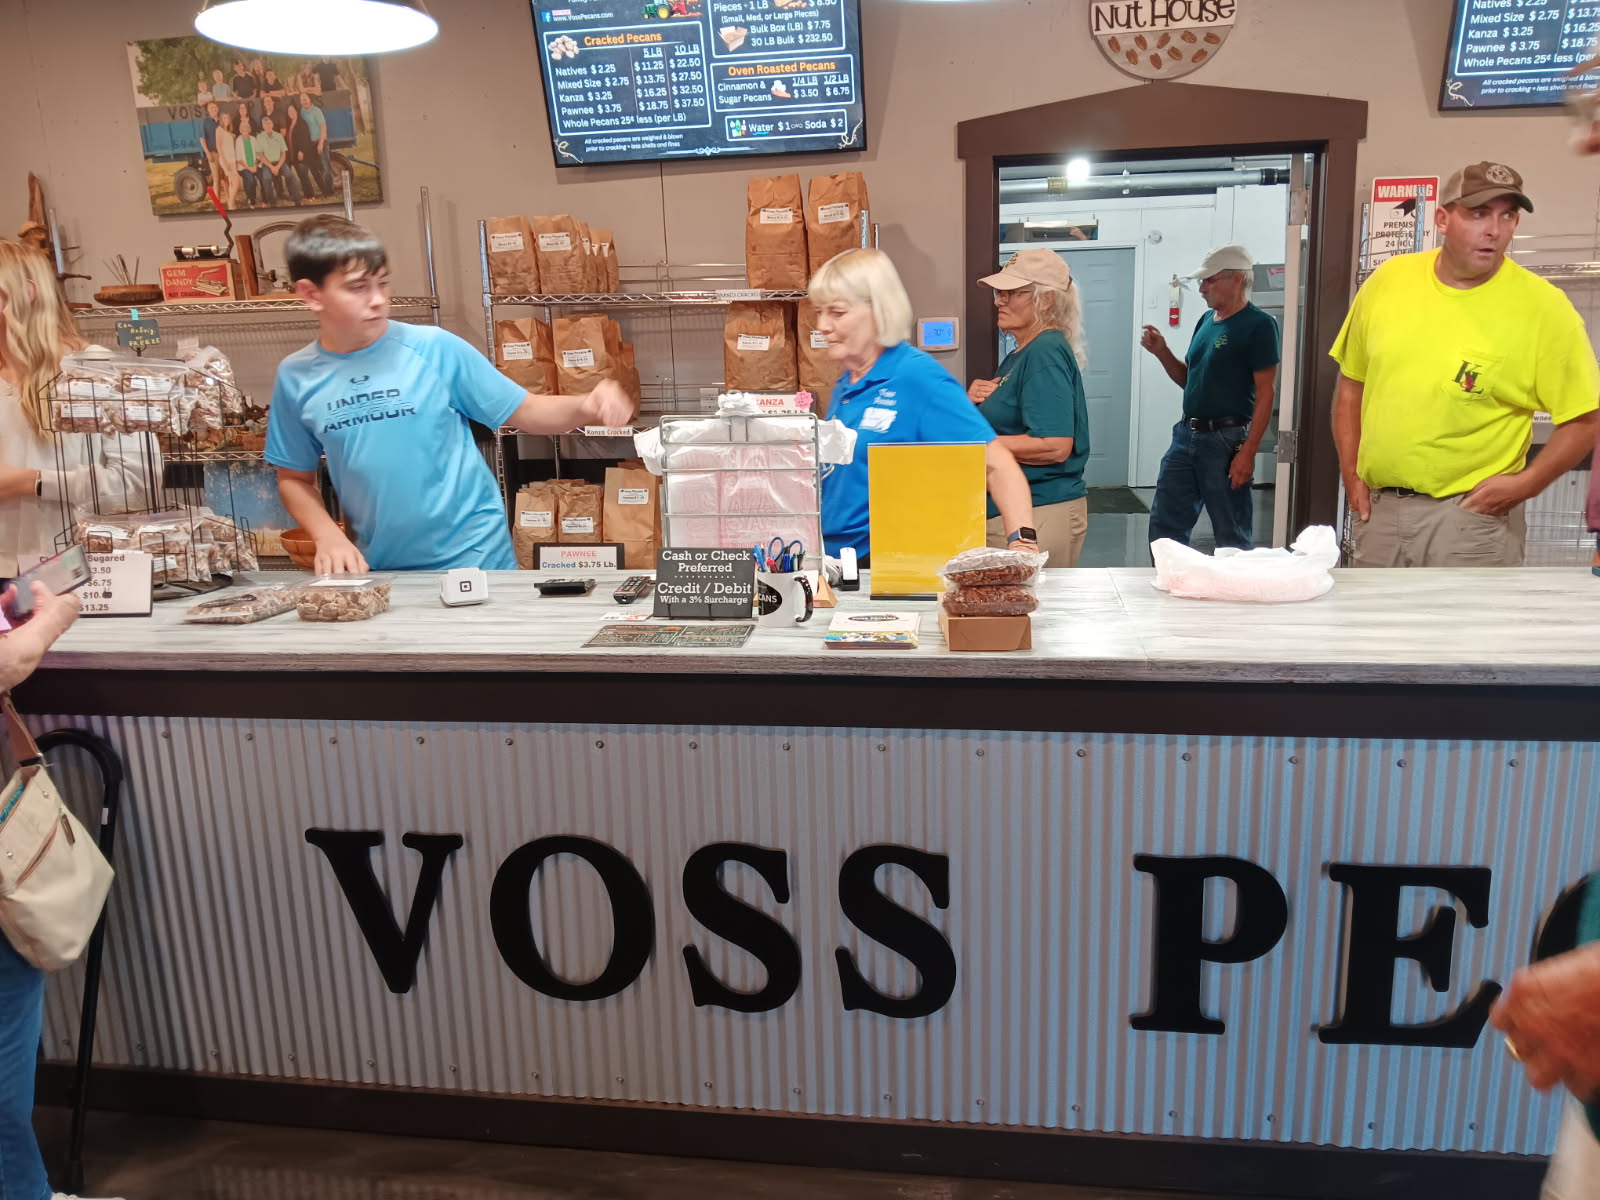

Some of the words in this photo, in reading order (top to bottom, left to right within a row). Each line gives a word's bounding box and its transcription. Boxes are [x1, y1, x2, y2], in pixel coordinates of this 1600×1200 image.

[714, 2, 742, 12] Pieces
[750, 2, 754, 10] 1
[757, 1, 768, 9] LB
[1473, 0, 1511, 9] Natives
[553, 12, 614, 22] www.VossPecans.com
[722, 15, 744, 24] (Small,
[746, 14, 763, 22] Med,
[773, 12, 793, 21] Large
[794, 10, 819, 18] Pieces)
[1095, 5, 1146, 31] Nut
[1150, 0, 1235, 27] House
[1471, 13, 1501, 24] Mixed
[1503, 12, 1524, 22] Size
[1538, 10, 1559, 20] 2.75
[751, 25, 768, 33] Bulk
[770, 23, 785, 32] Box
[787, 22, 803, 32] (LB)
[814, 21, 830, 29] 7.75
[1468, 29, 1498, 39] Kanza
[1511, 26, 1533, 36] 3.25
[584, 34, 624, 46] Cracked
[627, 33, 662, 42] Pecans
[752, 38, 762, 46] 30
[764, 37, 775, 45] LB
[777, 36, 795, 44] Bulk
[805, 33, 833, 42] 232.50
[1466, 44, 1505, 53] Pawnee
[1519, 41, 1540, 50] 3.75
[1570, 37, 1598, 48] 18.75
[643, 48, 649, 57] 5
[651, 47, 663, 56] LB
[675, 45, 686, 54] 10
[688, 45, 699, 53] LB
[555, 66, 587, 76] Natives
[598, 64, 616, 73] 2.25
[642, 61, 664, 70] 11.25
[677, 58, 700, 67] 22.50
[1464, 57, 1494, 67] Whole
[1497, 56, 1532, 66] Pecans
[1554, 54, 1573, 63] less
[728, 67, 754, 76] Oven
[757, 63, 797, 75] Roasted
[800, 62, 836, 72] Pecans
[558, 80, 582, 90] Mixed
[584, 78, 601, 88] Size
[612, 77, 629, 86] 2.75
[644, 75, 666, 84] 13.75
[679, 71, 702, 81] 27.50
[792, 77, 805, 86] 1/4
[807, 76, 818, 84] LB
[824, 75, 837, 84] 1/2
[838, 74, 849, 83] LB
[718, 82, 758, 92] Cinnamon
[1505, 86, 1531, 94] cracking
[559, 94, 584, 103] Kanza
[595, 91, 613, 100] 3.25
[644, 88, 667, 97] 16.25
[679, 85, 703, 94] 32.50
[718, 95, 741, 105] Sugar
[743, 94, 772, 102] Pecans
[800, 88, 818, 97] 3.50
[833, 86, 849, 95] 6.75
[561, 106, 594, 116] Pawnee
[605, 104, 622, 113] 3.75
[646, 101, 668, 110] 18.75
[682, 98, 704, 107] 37.50
[563, 119, 589, 128] Whole
[591, 117, 619, 126] Pecans
[637, 114, 653, 123] less
[654, 114, 671, 124] (per
[673, 113, 687, 122] LB)
[749, 124, 774, 132] Water
[805, 120, 827, 129] Soda
[838, 119, 843, 127] 2
[1378, 184, 1433, 198] WARNIG
[167, 269, 186, 277] GEM
[166, 278, 192, 286] DANDY
[88, 555, 125, 563] Sugared
[662, 551, 692, 561] Cash
[695, 553, 707, 561] or
[711, 551, 750, 561] Check
[578, 561, 601, 569] $3.75
[678, 563, 732, 572] Preferred
[88, 579, 112, 587] $6.75
[657, 582, 700, 594] Credit
[703, 582, 711, 593] /
[714, 582, 751, 594] Debit
[660, 595, 679, 603] With
[704, 595, 748, 605] Surcharge
[304, 827, 957, 1019] VOSS
[1129, 853, 1590, 1049] PE
